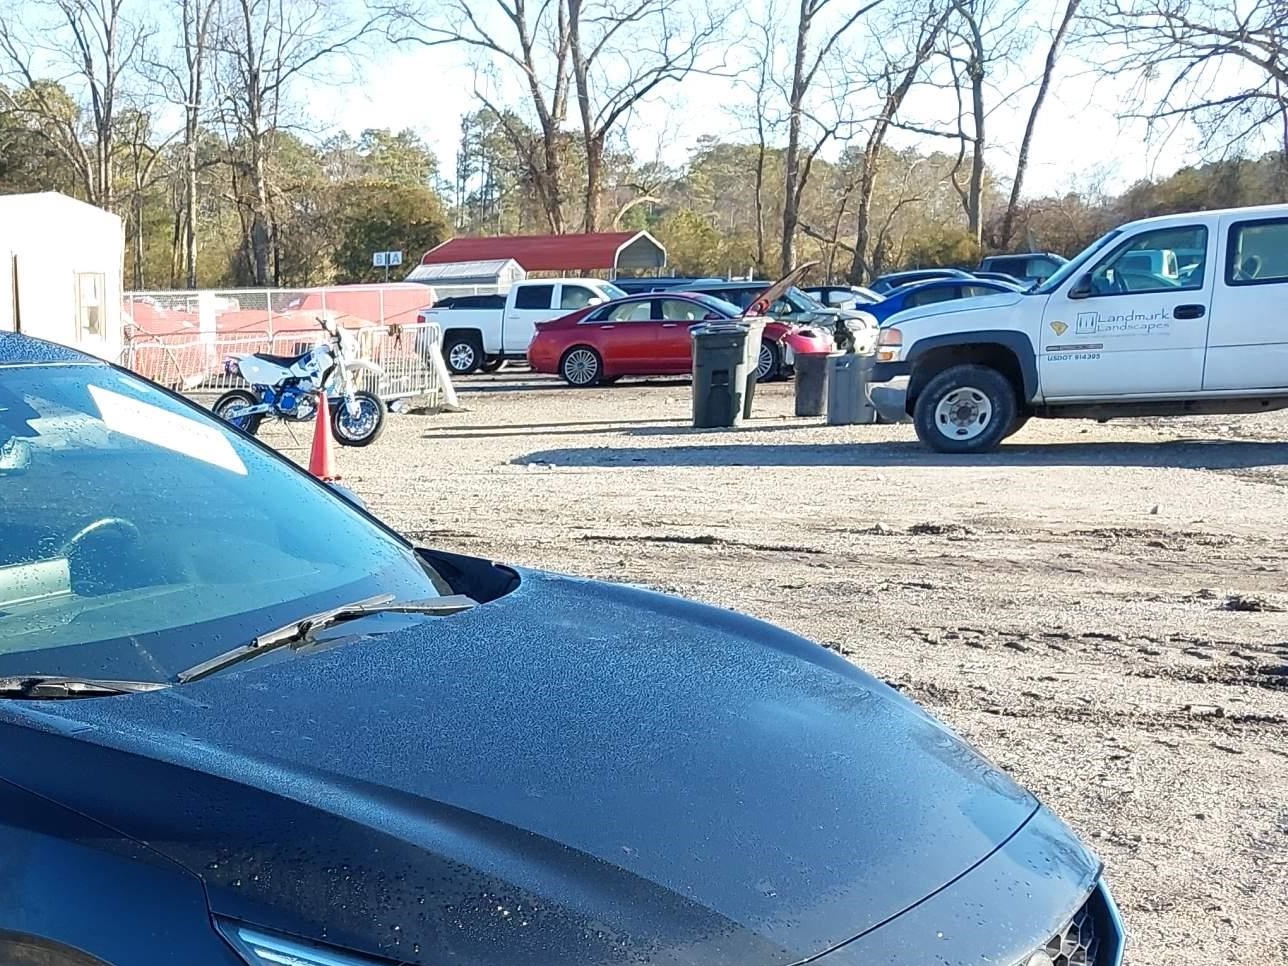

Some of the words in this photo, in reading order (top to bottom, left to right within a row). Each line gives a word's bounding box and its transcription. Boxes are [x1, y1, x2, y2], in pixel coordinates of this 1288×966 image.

[1098, 307, 1170, 323] Landmark
[1097, 321, 1170, 334] Landscapes
[1047, 354, 1073, 362] USDOT
